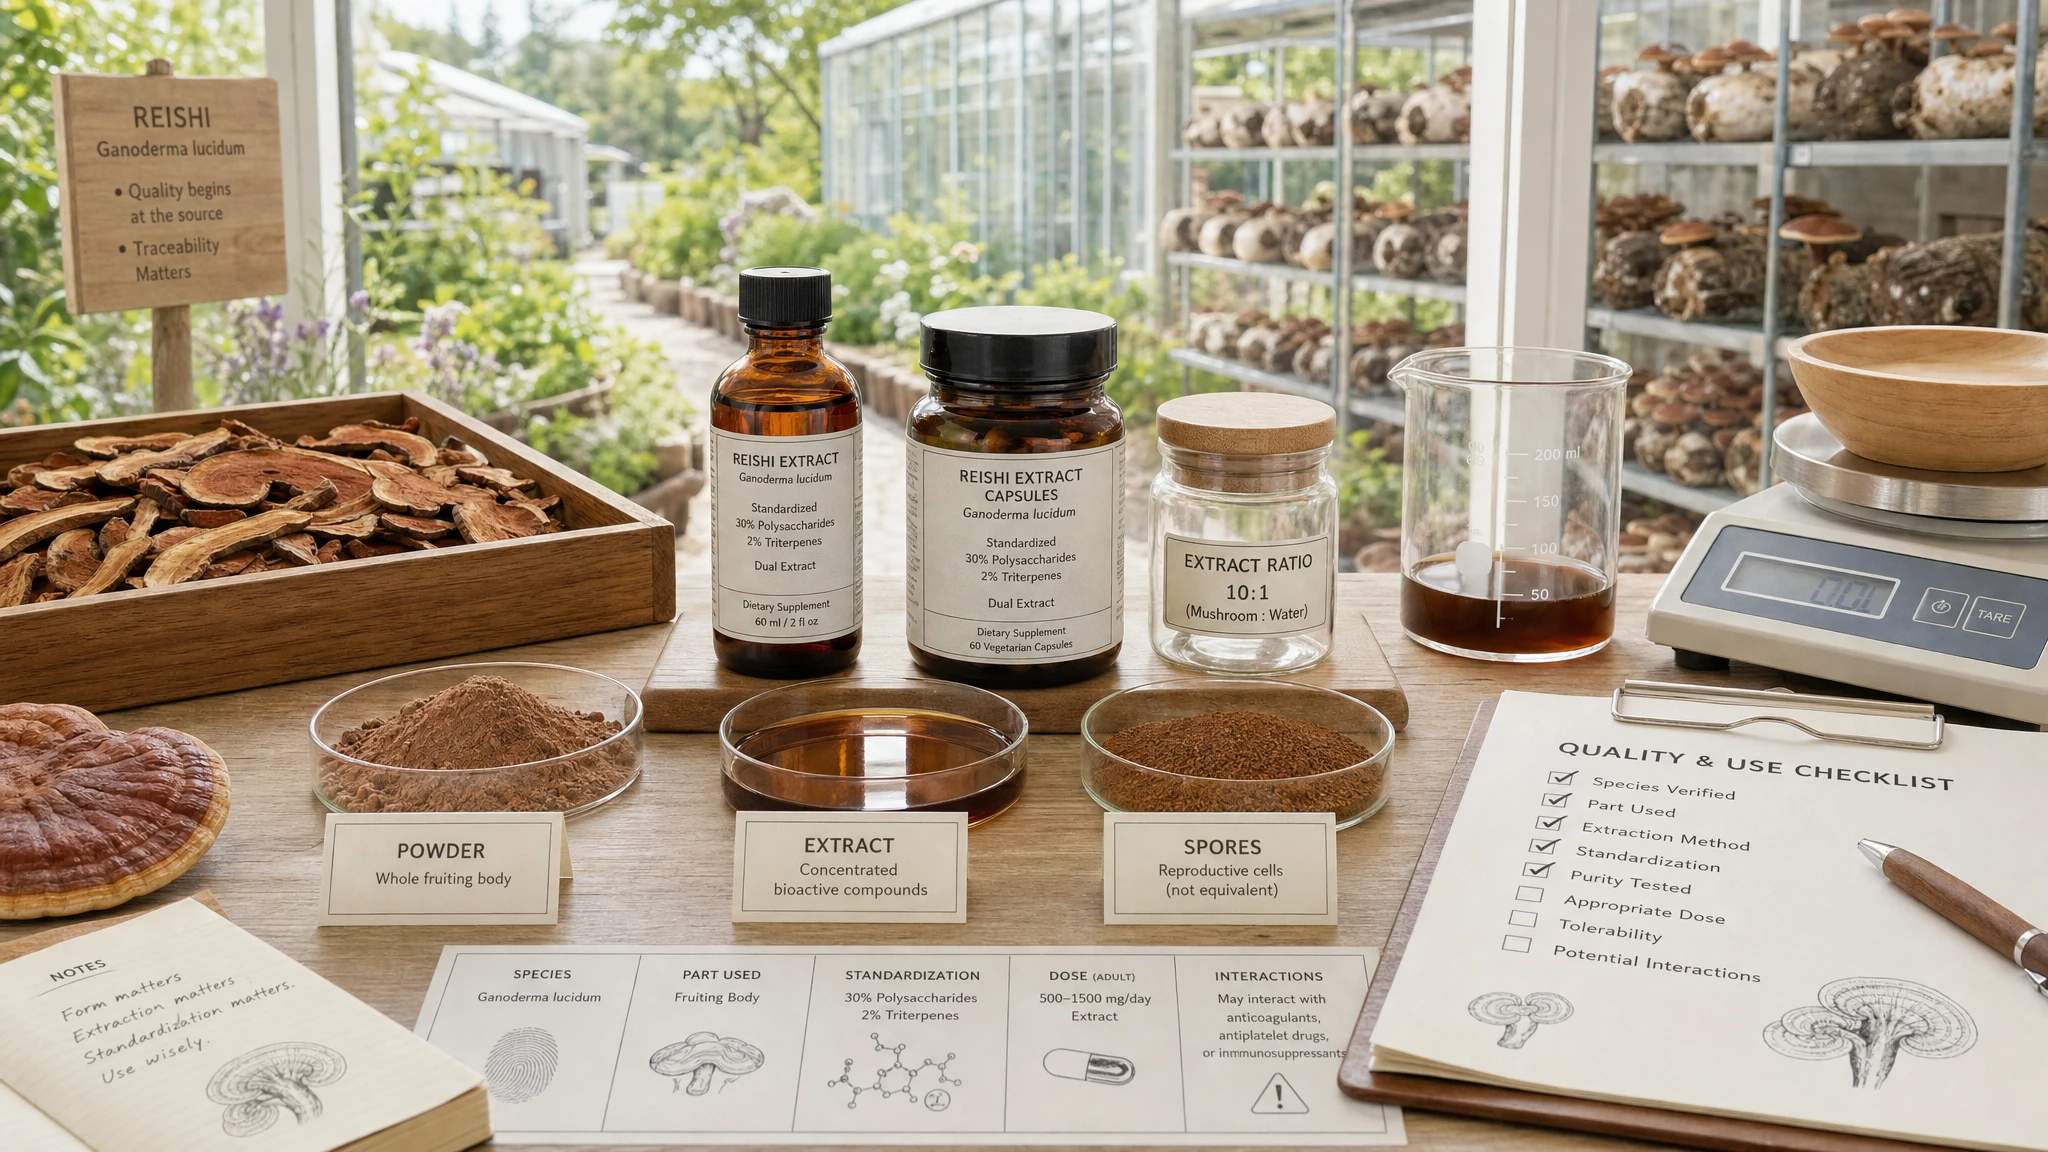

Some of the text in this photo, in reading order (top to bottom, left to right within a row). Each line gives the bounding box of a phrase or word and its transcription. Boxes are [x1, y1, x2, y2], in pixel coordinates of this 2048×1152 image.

[134, 106, 210, 128] REISHI
[97, 140, 245, 157] Ganoderma lucidum
[129, 181, 231, 201] Quality begins
[131, 208, 223, 224] at the source
[133, 237, 219, 256] Traceability
[136, 266, 191, 281] Matters
[734, 452, 839, 467] REISHI EXTRACT
[1534, 446, 1580, 461] 200 ml
[739, 472, 832, 484] Ganoderma lucidum
[960, 468, 1082, 484] REISHI EXTRACT
[985, 489, 1058, 502] CAPSULES
[1534, 495, 1559, 507] 150
[752, 502, 817, 513] Standardized
[963, 507, 1075, 519] Ganoderma lucidum
[736, 518, 834, 533] 30% Polysaccharides
[747, 536, 822, 549] 2% Triterpenes
[987, 536, 1055, 548] Standardized
[1532, 543, 1557, 554] 100
[755, 561, 816, 571] Dual Extract
[966, 552, 1076, 568] 30% Polysaccharides
[1185, 554, 1312, 572] EXTRACT RATIO
[981, 571, 1061, 584] 2% Triterpenes
[1228, 585, 1268, 600] 10:1
[1531, 589, 1549, 601] 50
[743, 600, 830, 613] Dietary Supplement
[989, 598, 1054, 608] Dual Extract
[1186, 604, 1257, 621] (Mushroom
[1269, 604, 1307, 620] Water)
[1978, 609, 2013, 624] TARE
[755, 617, 766, 626] 60
[770, 618, 780, 627] ml
[783, 618, 788, 627] /
[791, 618, 796, 627] 2
[799, 617, 804, 626] fl
[978, 628, 1066, 639] Dietary Supplement
[970, 640, 1073, 653] 60 Vegetarian Capsules
[1559, 743, 1954, 790] QUALITY & USE CHECKLIST
[1593, 777, 1735, 800] Species Verified
[1588, 800, 1675, 818] Part Used
[1583, 822, 1749, 851] Extraction Method
[398, 843, 484, 858] POWDER
[805, 838, 894, 853] EXTRACT
[1185, 840, 1261, 854] SPORES
[1576, 845, 1722, 873] Standardization
[800, 863, 897, 876] Concentrated
[1160, 864, 1283, 879] Reproductive cells
[376, 872, 511, 888] Whole fruiting body
[1571, 871, 1691, 894] Purity Tested
[775, 883, 927, 899] bioactive compounds
[1167, 883, 1278, 899] (not equivalent)
[1564, 895, 1725, 924] Appropriate Dose
[1560, 919, 1662, 944] Tolerability
[50, 959, 106, 982] NOTES
[1554, 945, 1760, 982] Potential Interactions
[514, 970, 571, 979] SPECIES
[683, 970, 760, 979] PART USED
[846, 971, 979, 980] STANDARDIZATION
[1050, 972, 1135, 982] DOSE (ADULT)
[1216, 972, 1323, 981] INTERACTIONS
[62, 972, 181, 1022] Form matters
[478, 992, 601, 1002] Ganoderma lucidum
[675, 992, 759, 1005] Fruiting Body
[845, 993, 977, 1005] 30% Polysaccharides
[1106, 993, 1151, 1006] mg/day
[1218, 994, 1325, 1006] May interact with
[73, 976, 235, 1044] Extraction matters
[862, 1010, 959, 1022] 2% Triterpenes
[1072, 1011, 1118, 1021] Extract
[84, 981, 295, 1065] Standardization matters.
[1227, 1013, 1320, 1025] anticoagulants,
[1219, 1030, 1328, 1043] antiplatelet drugs,
[102, 1037, 210, 1084] Use wisely.
